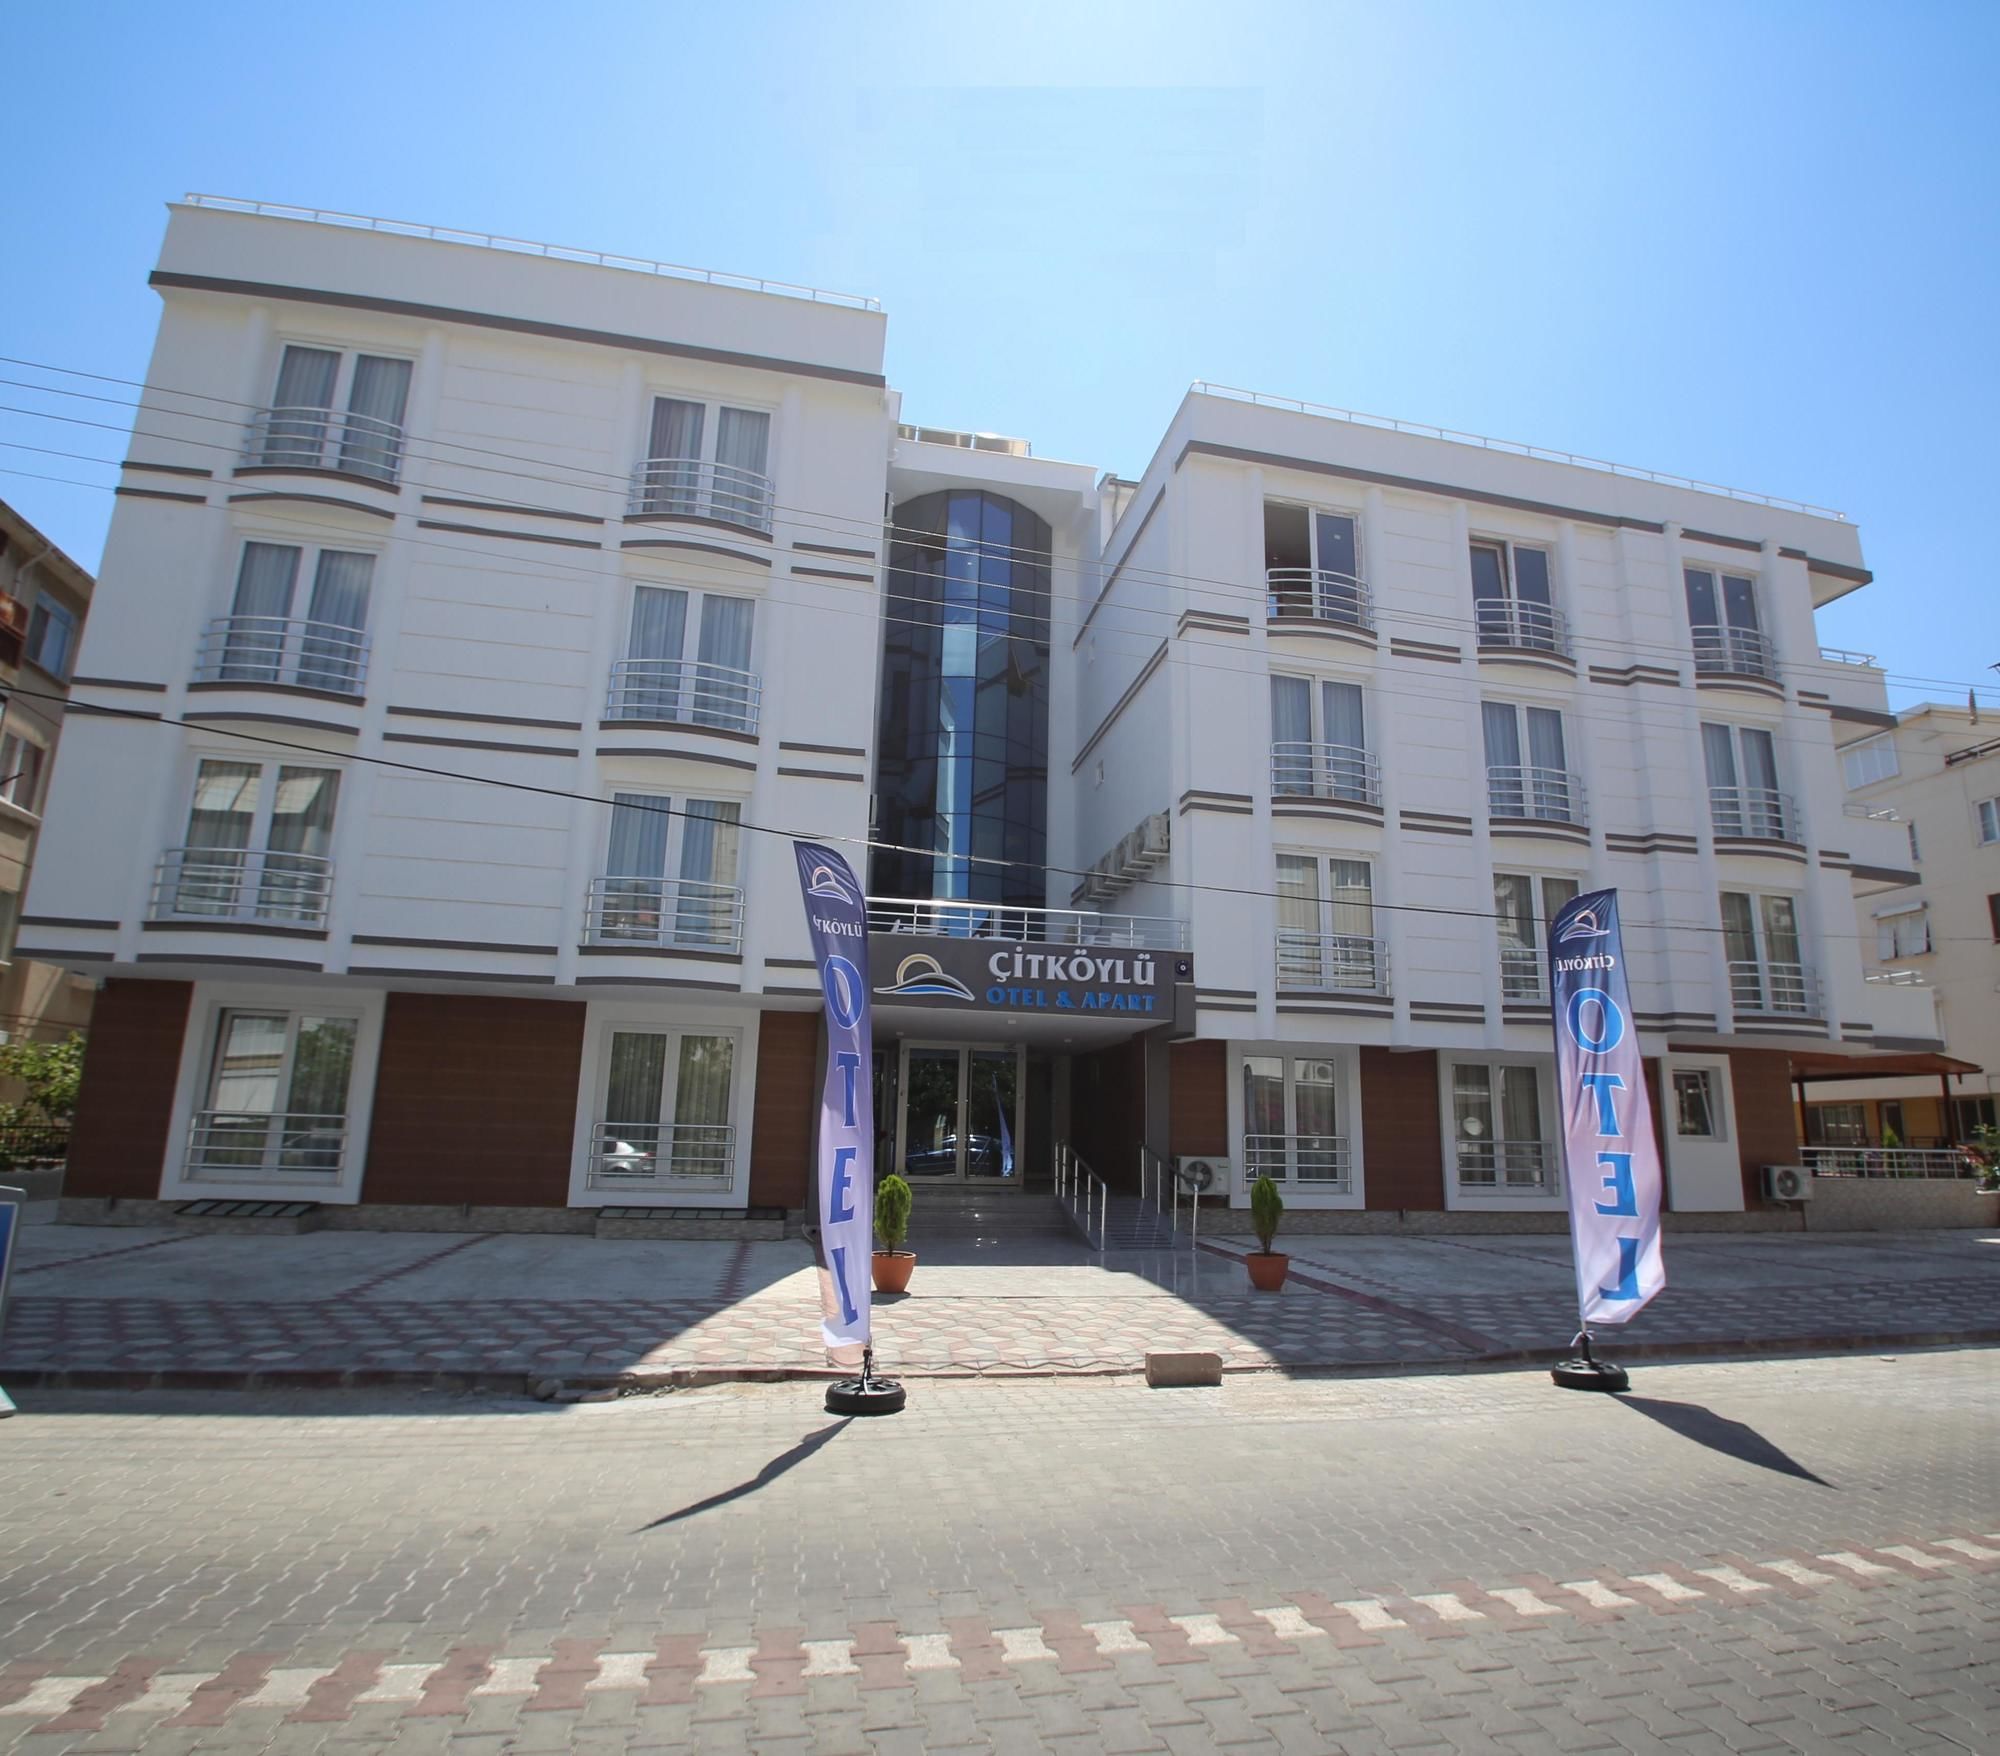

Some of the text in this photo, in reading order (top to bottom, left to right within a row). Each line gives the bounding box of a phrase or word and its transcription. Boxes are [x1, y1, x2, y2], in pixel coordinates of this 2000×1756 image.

[812, 914, 863, 938] TKÖYLÜ
[988, 946, 1156, 986] ÇİTKÖYLÜ
[986, 986, 1159, 1012] OTEL & APART
